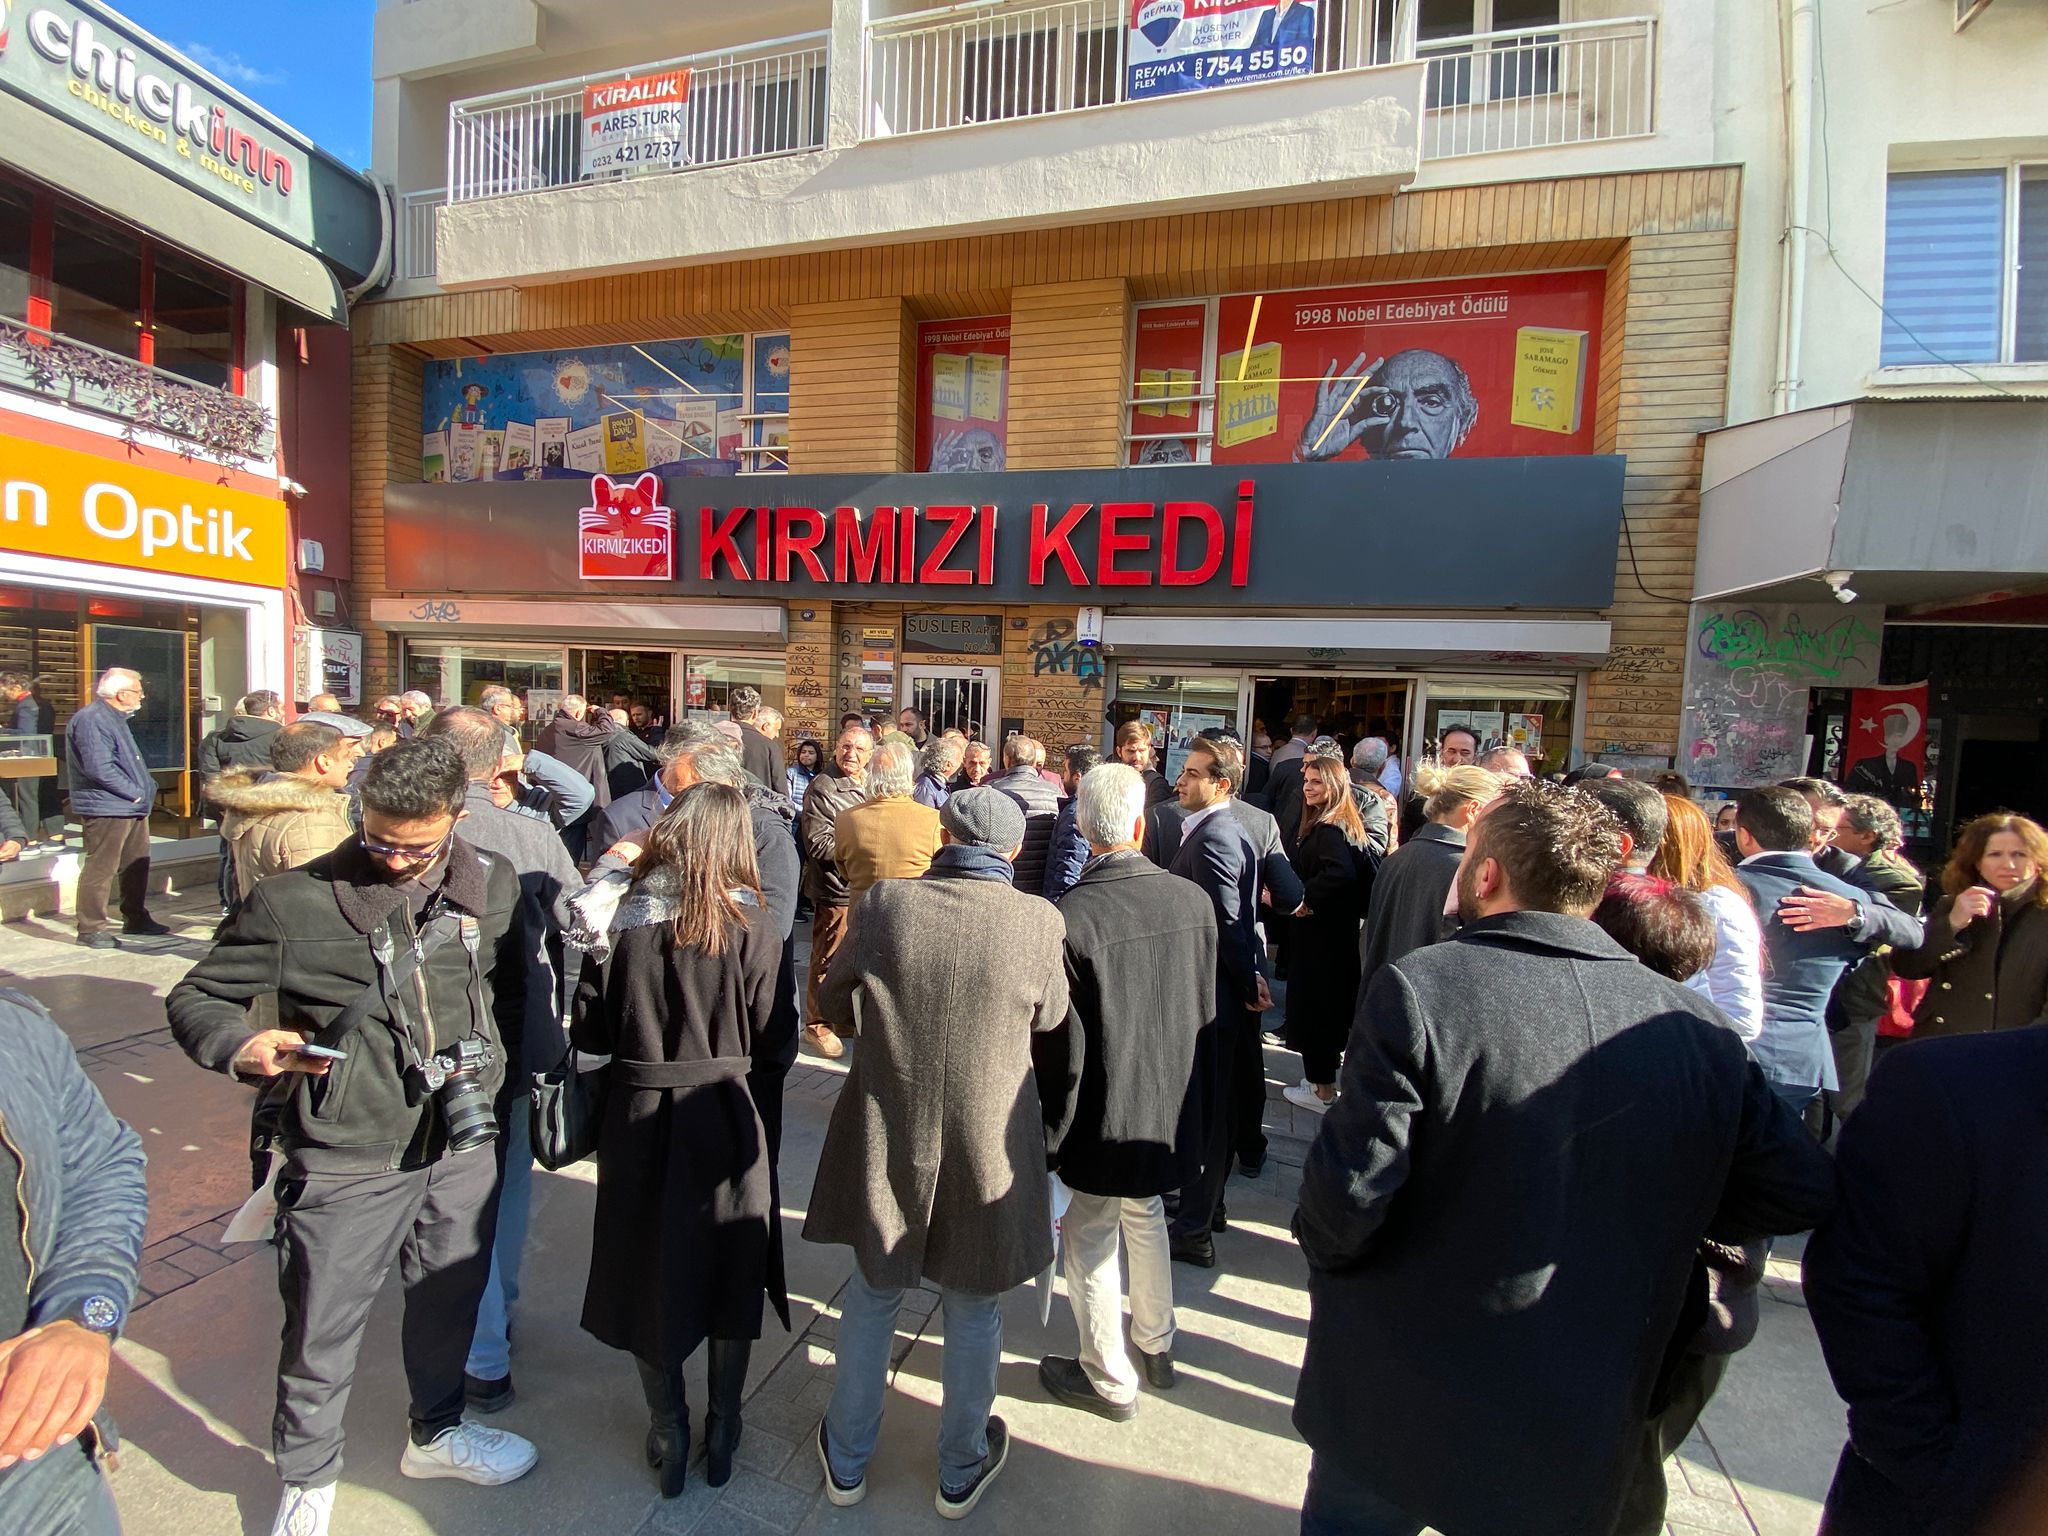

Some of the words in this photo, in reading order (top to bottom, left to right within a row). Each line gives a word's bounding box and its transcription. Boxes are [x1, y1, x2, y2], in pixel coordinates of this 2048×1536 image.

[1144, 4, 1179, 20] RE/MAX
[1135, 61, 1185, 80] RE/MAX
[1206, 56, 1244, 78] 754
[1248, 49, 1274, 71] 55
[1279, 45, 1307, 67] 50
[1135, 78, 1156, 90] FLEX
[1224, 66, 1306, 85] www.remax.com.tr/flex
[26, 8, 293, 196] chickinn
[68, 79, 167, 145] chicken
[175, 138, 192, 159] &
[200, 153, 254, 193] more
[592, 154, 612, 168] 0232
[615, 145, 640, 163] 421
[644, 140, 681, 160] 2737
[1294, 308, 1332, 326] 1998
[1336, 304, 1380, 323] Nobel
[1385, 300, 1456, 320] Edebiyat
[1461, 295, 1509, 315] Ödülü
[924, 334, 941, 344] 1998
[942, 333, 962, 342] Nobel
[963, 330, 994, 343] Edebiyat
[1524, 352, 1569, 366] SARAMAGO
[82, 482, 254, 562] Optik
[700, 504, 998, 586] KIRMIZI
[1029, 479, 1255, 587] KEDİ
[584, 533, 667, 555] KIRMIZIKEDİ
[907, 618, 972, 635] SUSLER
[840, 675, 850, 690] 4
[840, 696, 850, 713] 3
[810, 730, 826, 738] YOU
